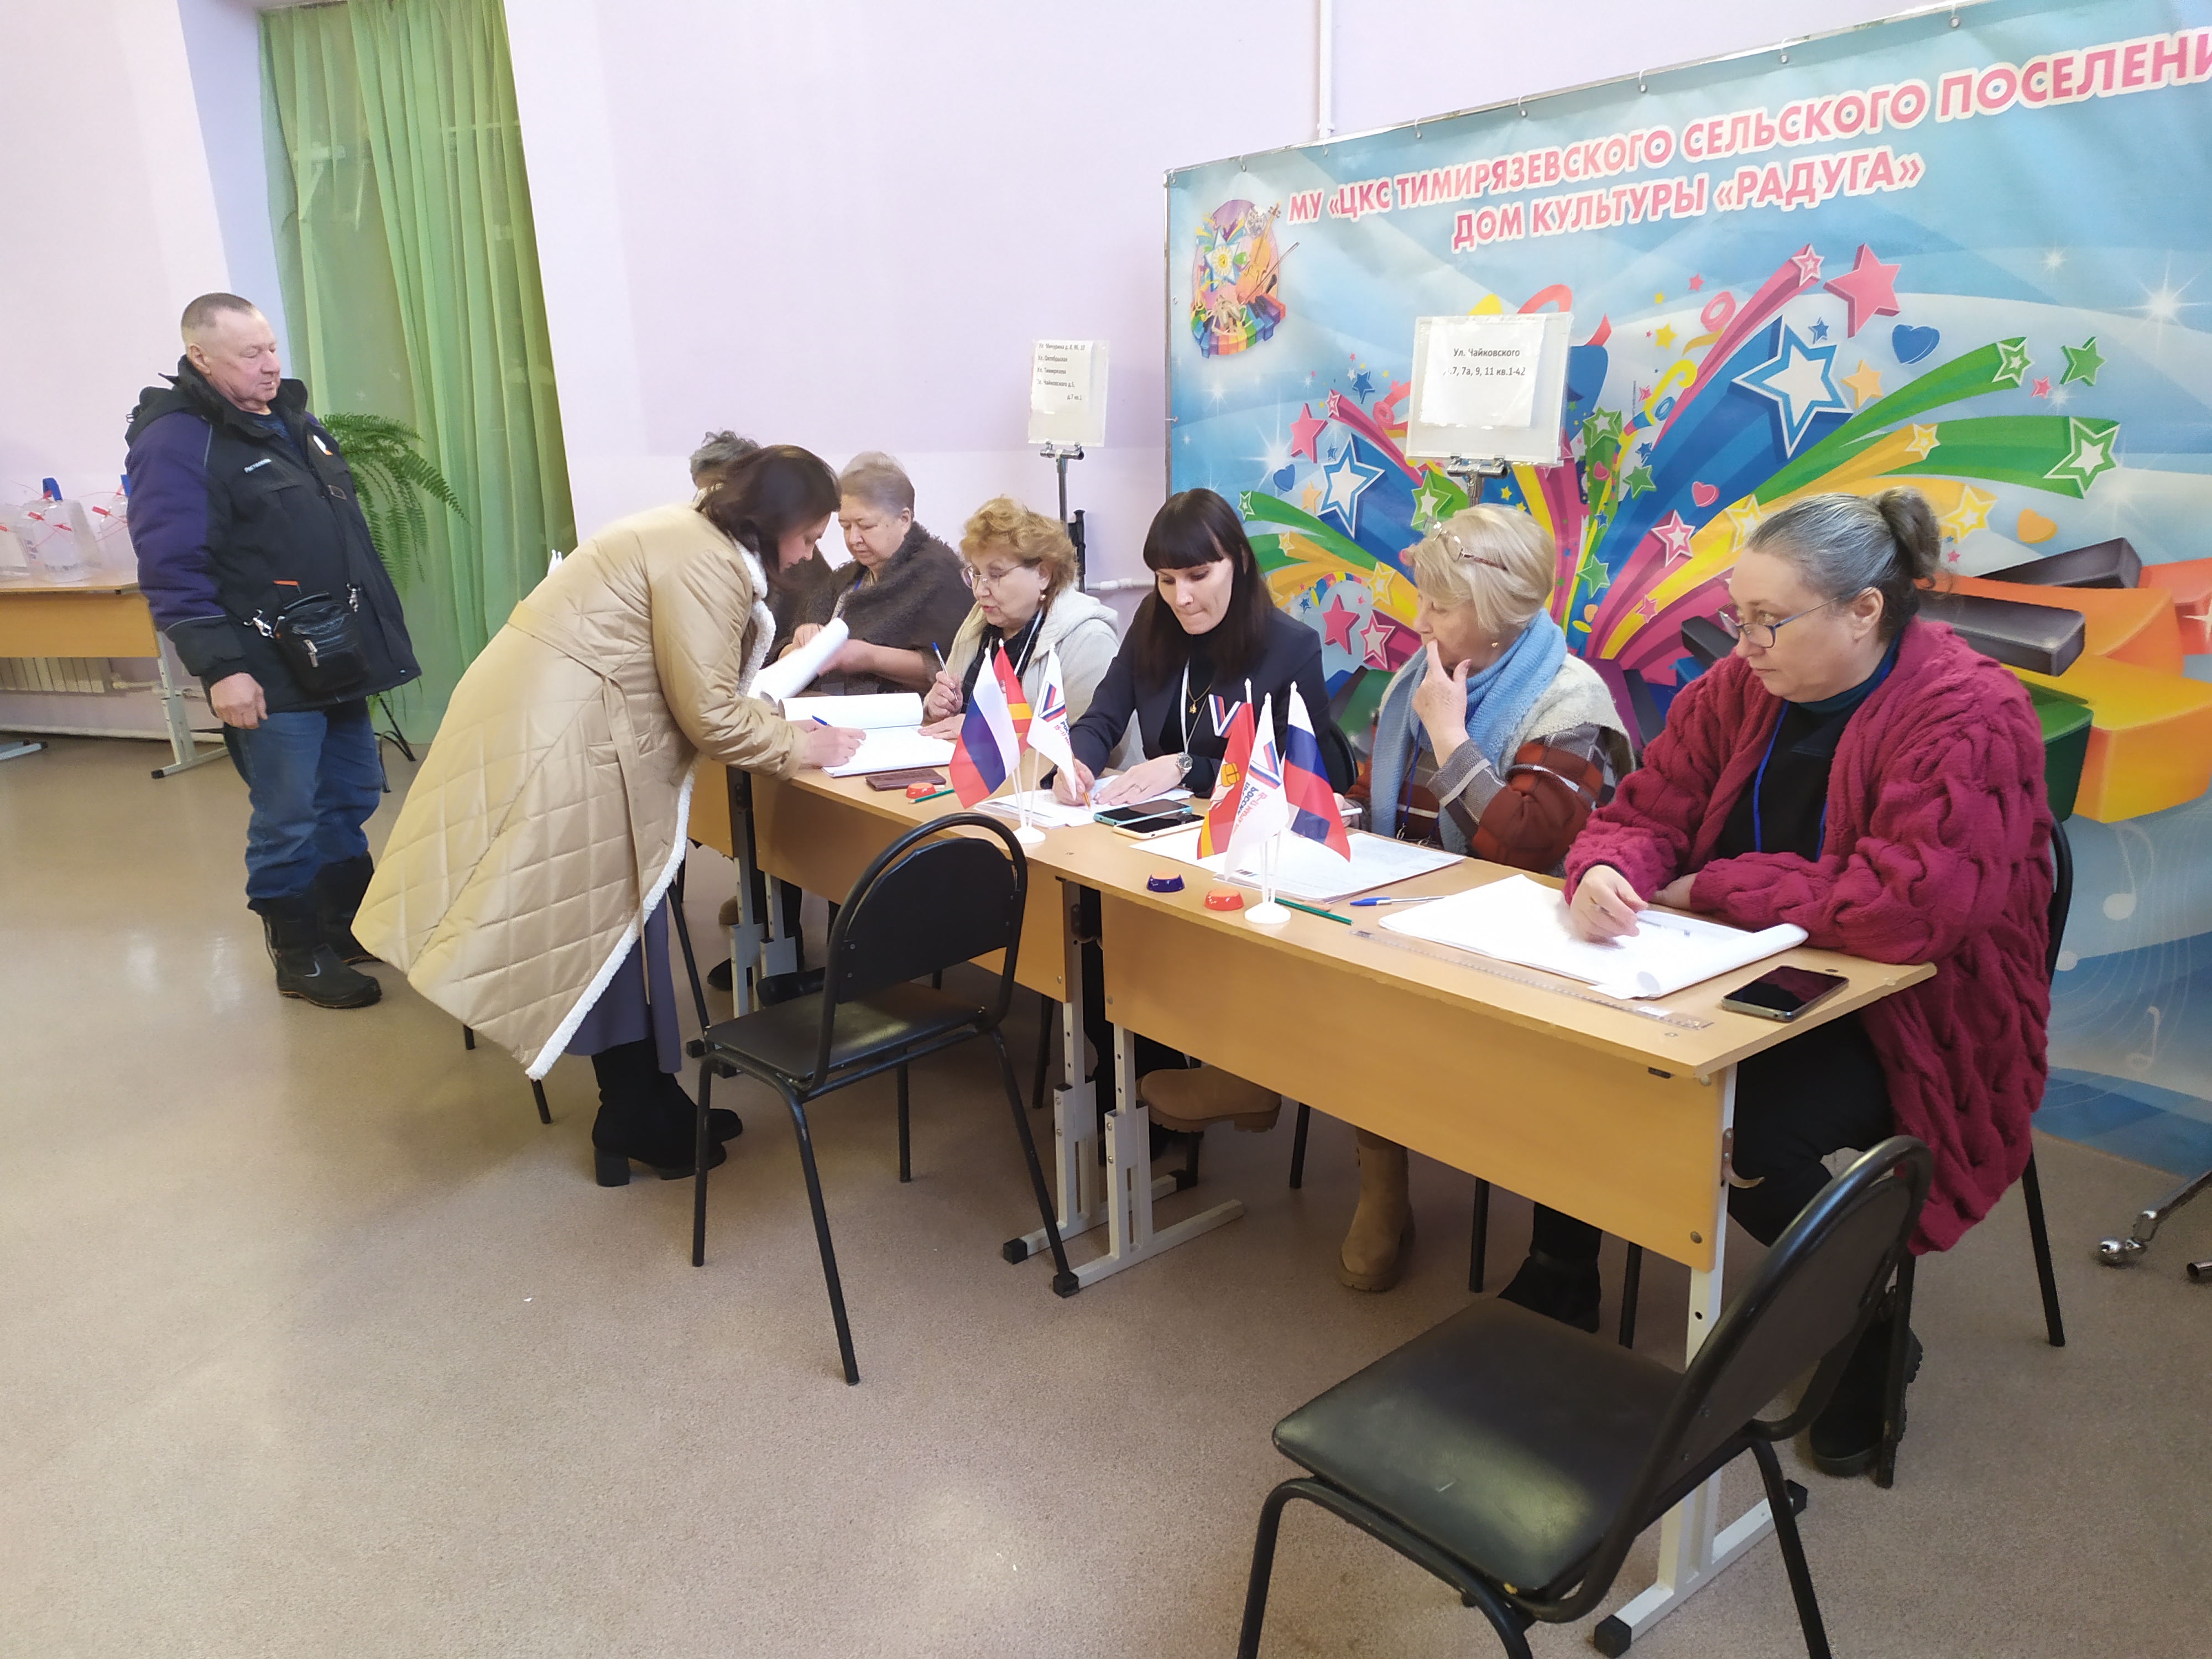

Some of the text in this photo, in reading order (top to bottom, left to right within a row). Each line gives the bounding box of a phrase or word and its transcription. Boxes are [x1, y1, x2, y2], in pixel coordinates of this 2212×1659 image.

[1289, 192, 1322, 222] МУ
[1329, 181, 1390, 218] «ЦКС
[1396, 129, 1673, 206] ТИМИРЯЗЕВСКОГО
[1684, 84, 1926, 158] СЕЛЬСКОГО
[1453, 150, 1921, 251] ДОМ КУЛЬТУРЫ «РАДУГА»
[1453, 347, 1520, 357] Ул. Чайковского
[1462, 366, 1473, 377] 7а,
[1475, 366, 1483, 377] 9,
[1485, 367, 1494, 375] 11
